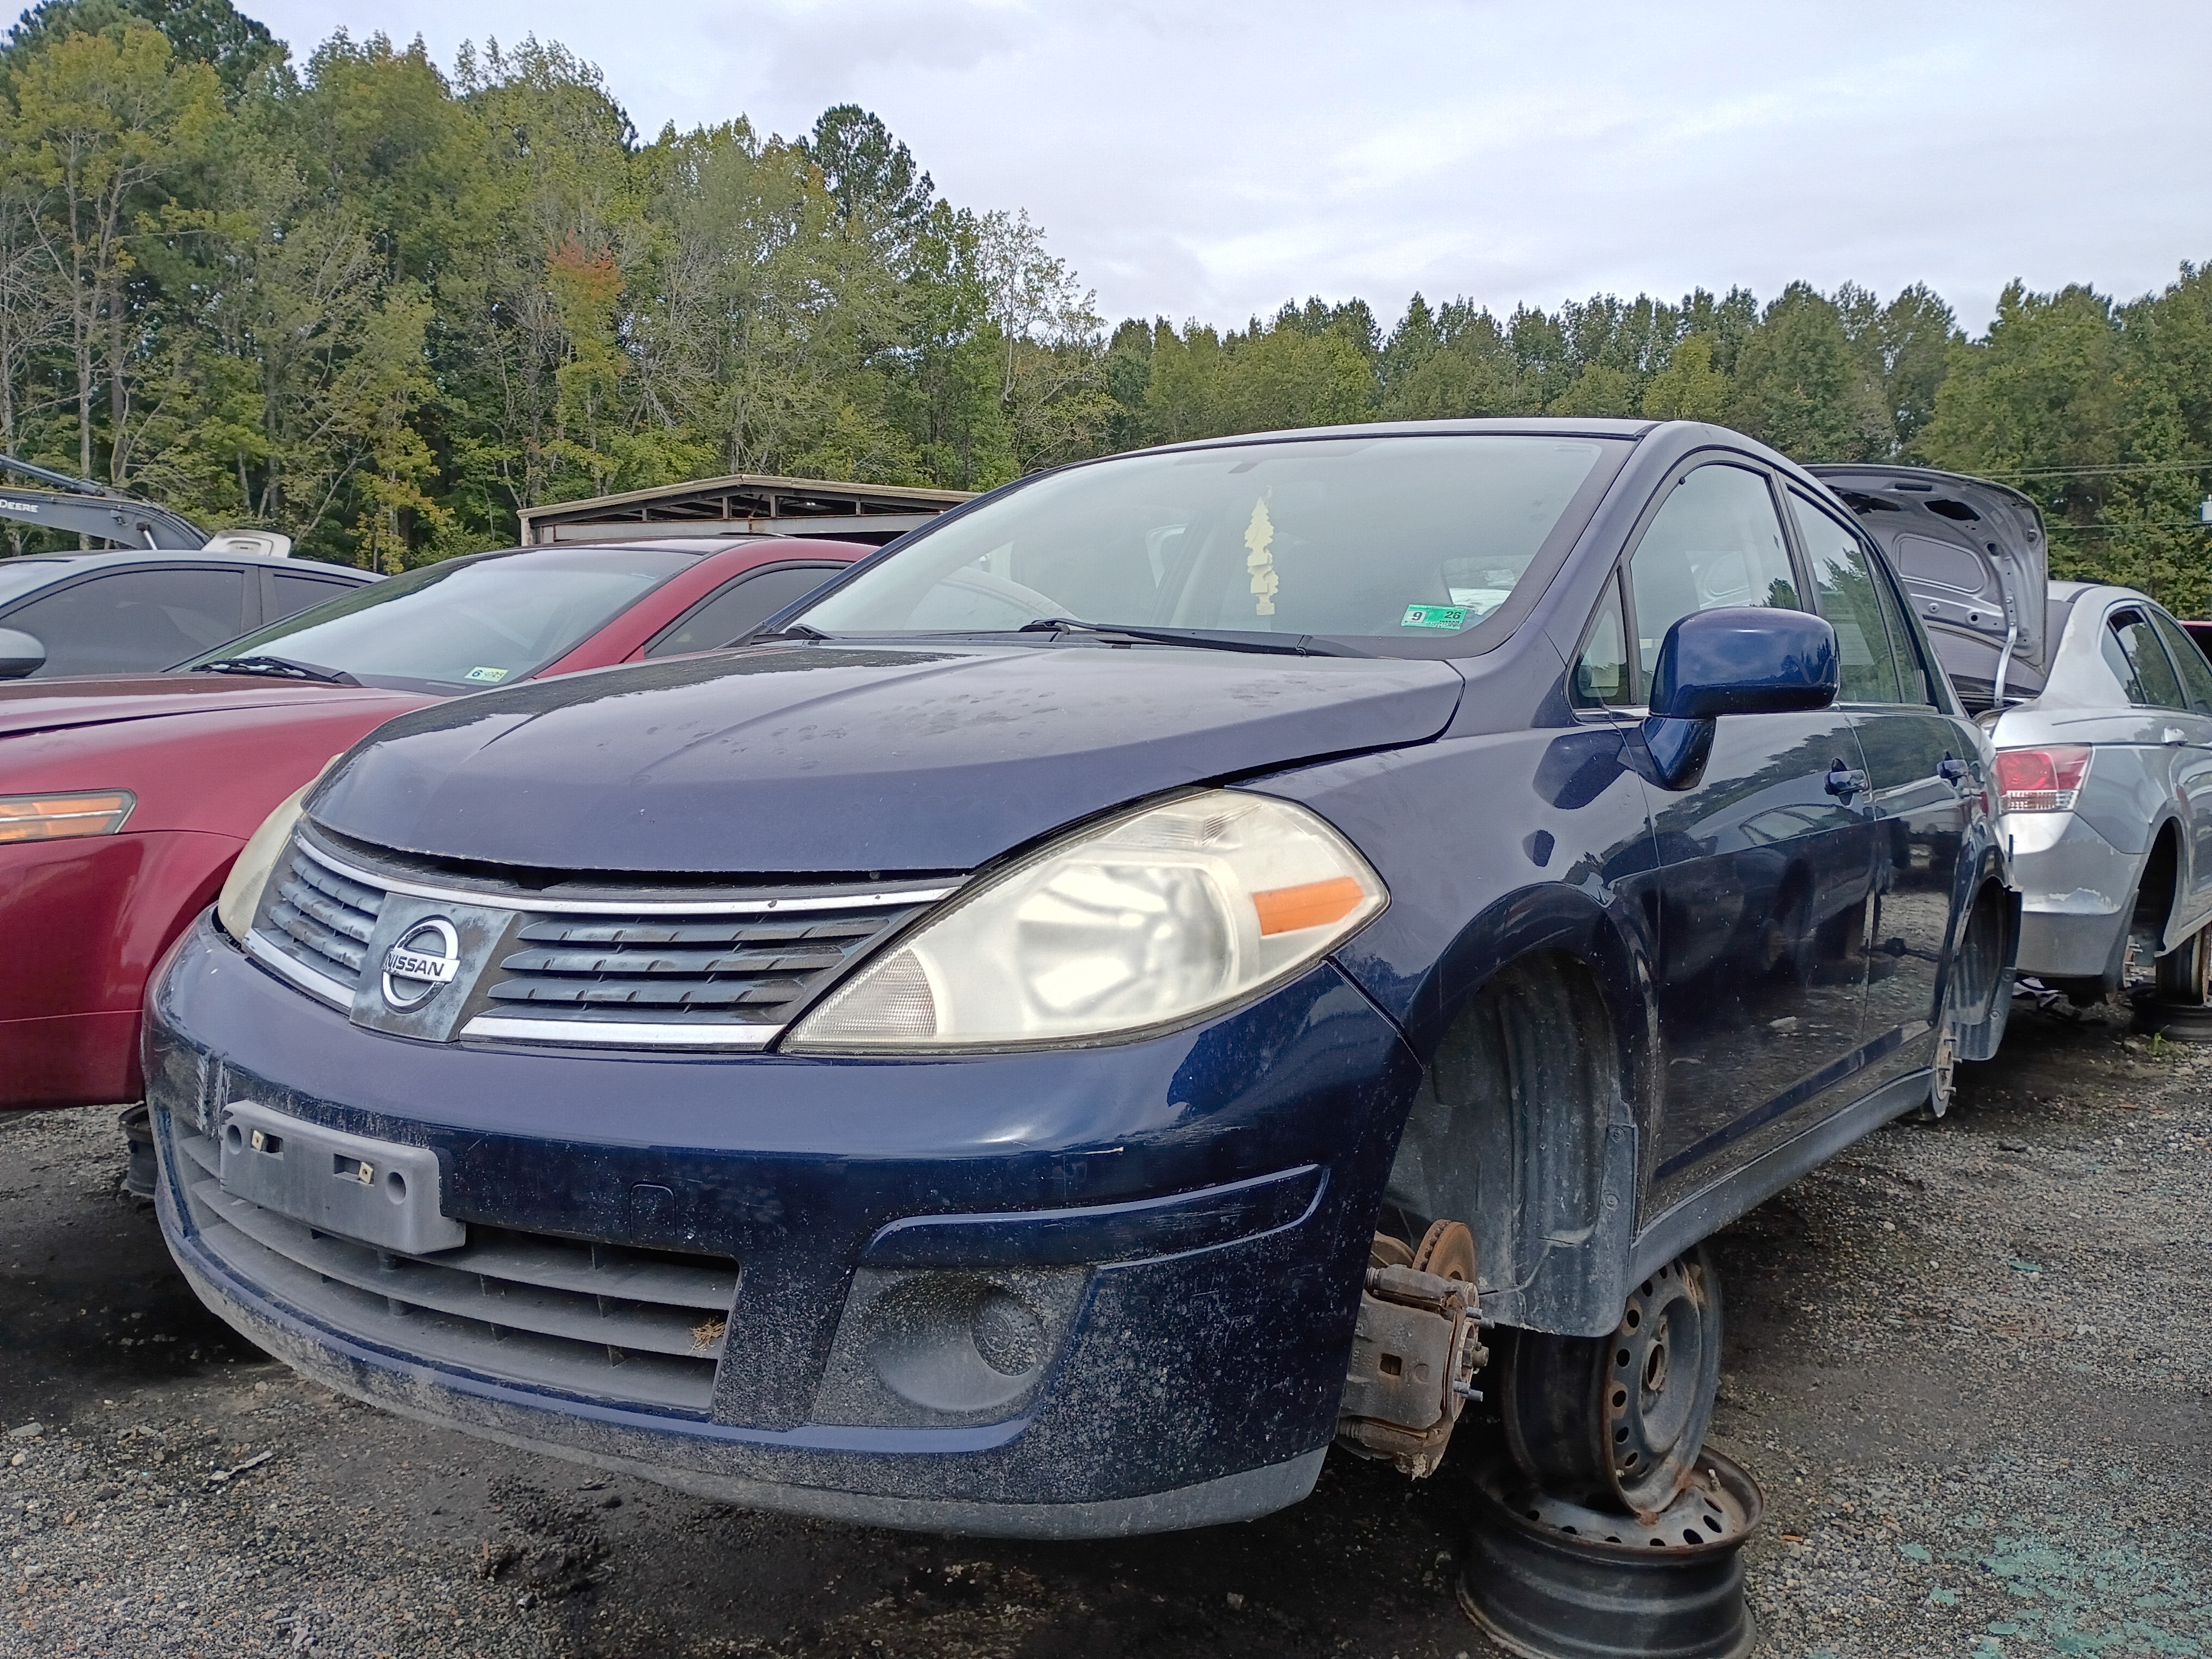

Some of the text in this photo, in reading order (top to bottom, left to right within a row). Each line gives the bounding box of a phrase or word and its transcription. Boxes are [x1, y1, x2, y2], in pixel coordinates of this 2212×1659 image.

[0, 499, 38, 513] DEERE
[1412, 610, 1462, 621] 9 26
[383, 953, 445, 976] NISSAN
